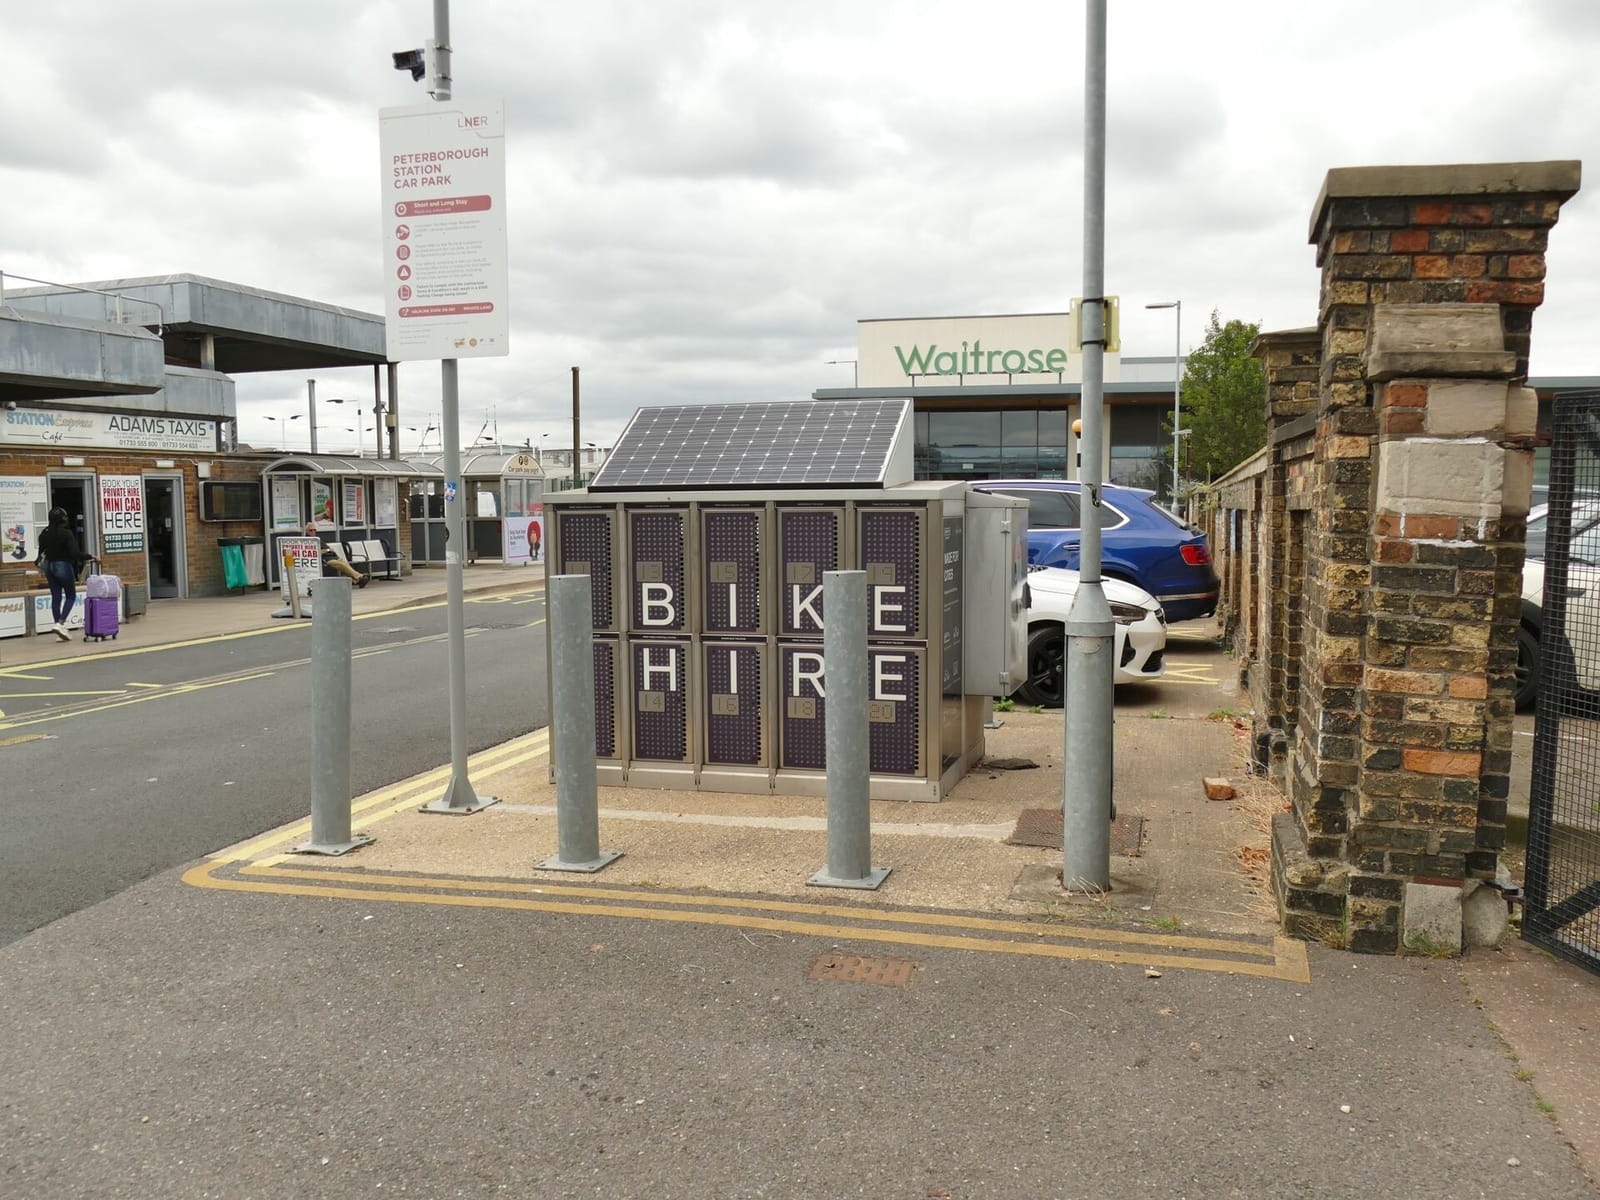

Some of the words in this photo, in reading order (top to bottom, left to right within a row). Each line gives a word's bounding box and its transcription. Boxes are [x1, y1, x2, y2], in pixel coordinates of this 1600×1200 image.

[458, 116, 488, 128] LNER
[393, 147, 489, 165] PETERBOROUGH
[393, 164, 442, 177] STATION
[394, 178, 418, 189] CAR
[421, 175, 452, 186] PARK
[894, 339, 1068, 376] Waitrose
[6, 411, 55, 426] STATION
[108, 416, 165, 434] ADAMS
[168, 420, 207, 436] TAXIS
[103, 488, 126, 496] PRIVATE
[127, 488, 140, 496] HIRE
[104, 498, 122, 512] MINI
[125, 498, 141, 511] CAB
[105, 512, 141, 528] HERE
[291, 558, 317, 568] ERE
[717, 564, 736, 580] 15
[642, 582, 907, 632] BIKE
[642, 647, 907, 701] HIRE
[644, 693, 662, 706] 14
